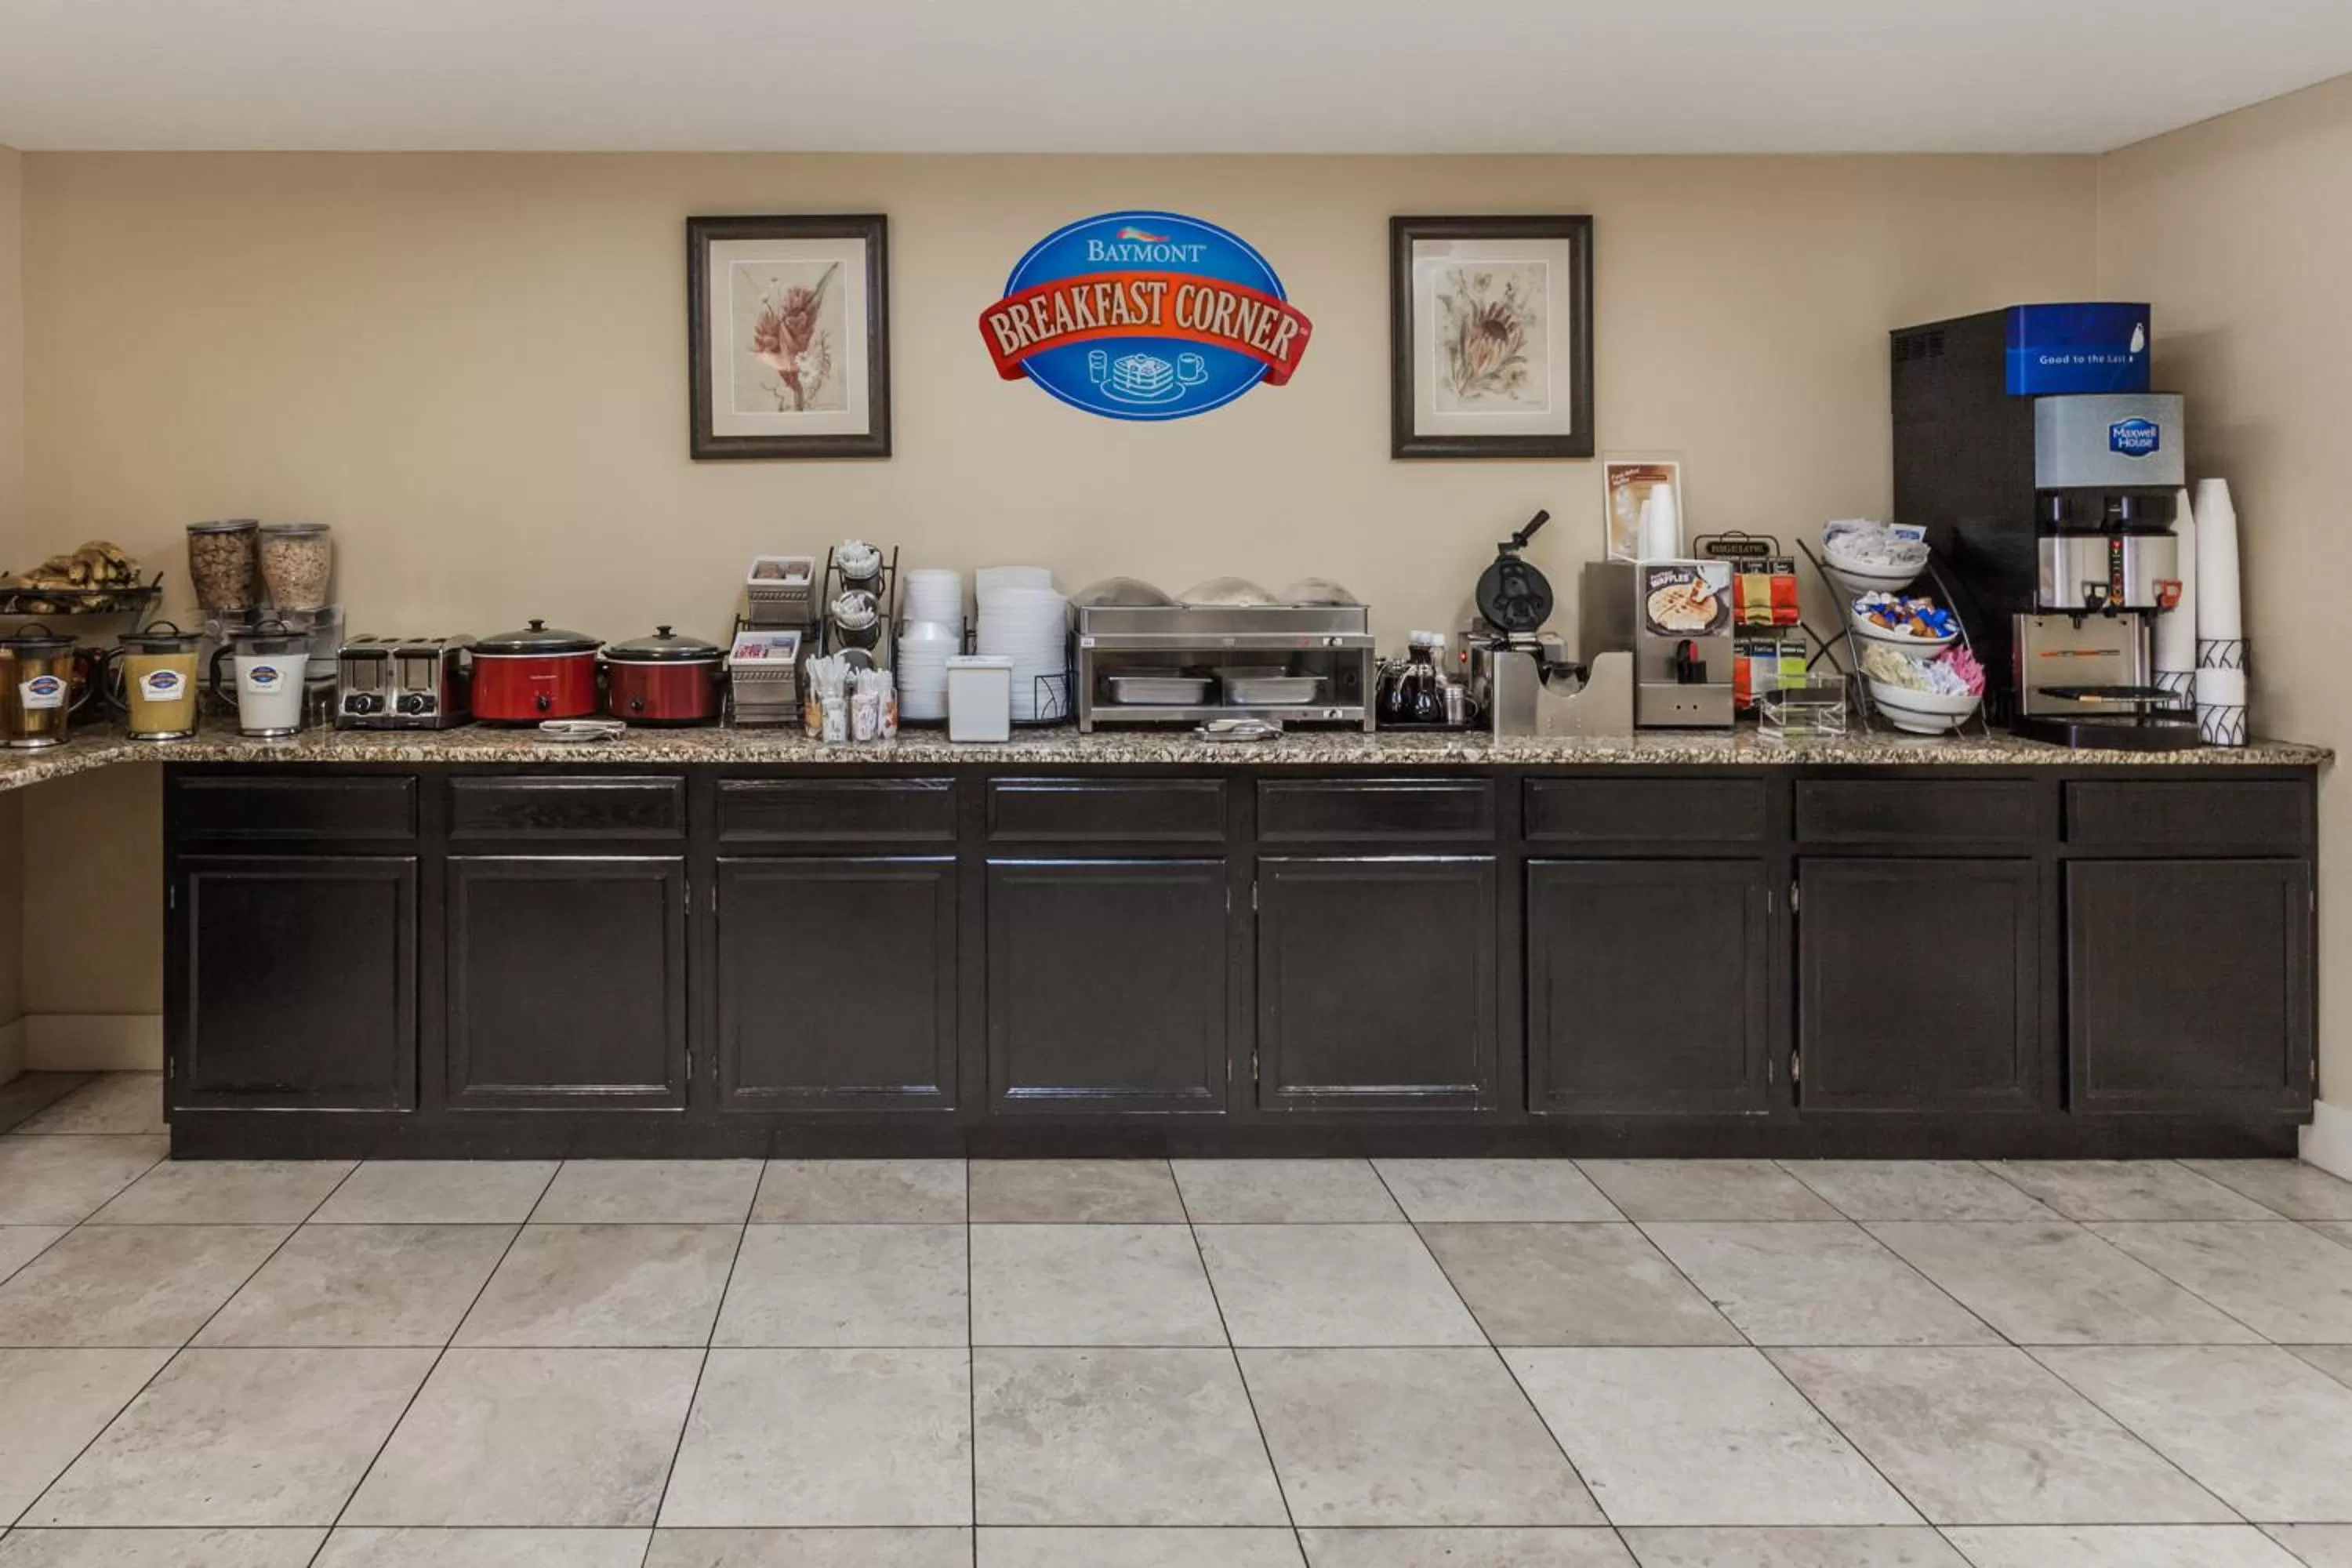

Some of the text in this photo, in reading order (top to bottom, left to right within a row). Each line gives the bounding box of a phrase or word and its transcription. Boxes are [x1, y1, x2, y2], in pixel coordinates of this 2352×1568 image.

[1087, 239, 1204, 263] BAYMONT
[989, 281, 1300, 361] BREAKFAST CORNER
[2039, 354, 2069, 365] Good
[2074, 355, 2085, 364] to
[2088, 354, 2104, 364] the
[2113, 426, 2157, 439] Maxwell
[2118, 437, 2154, 448] House
